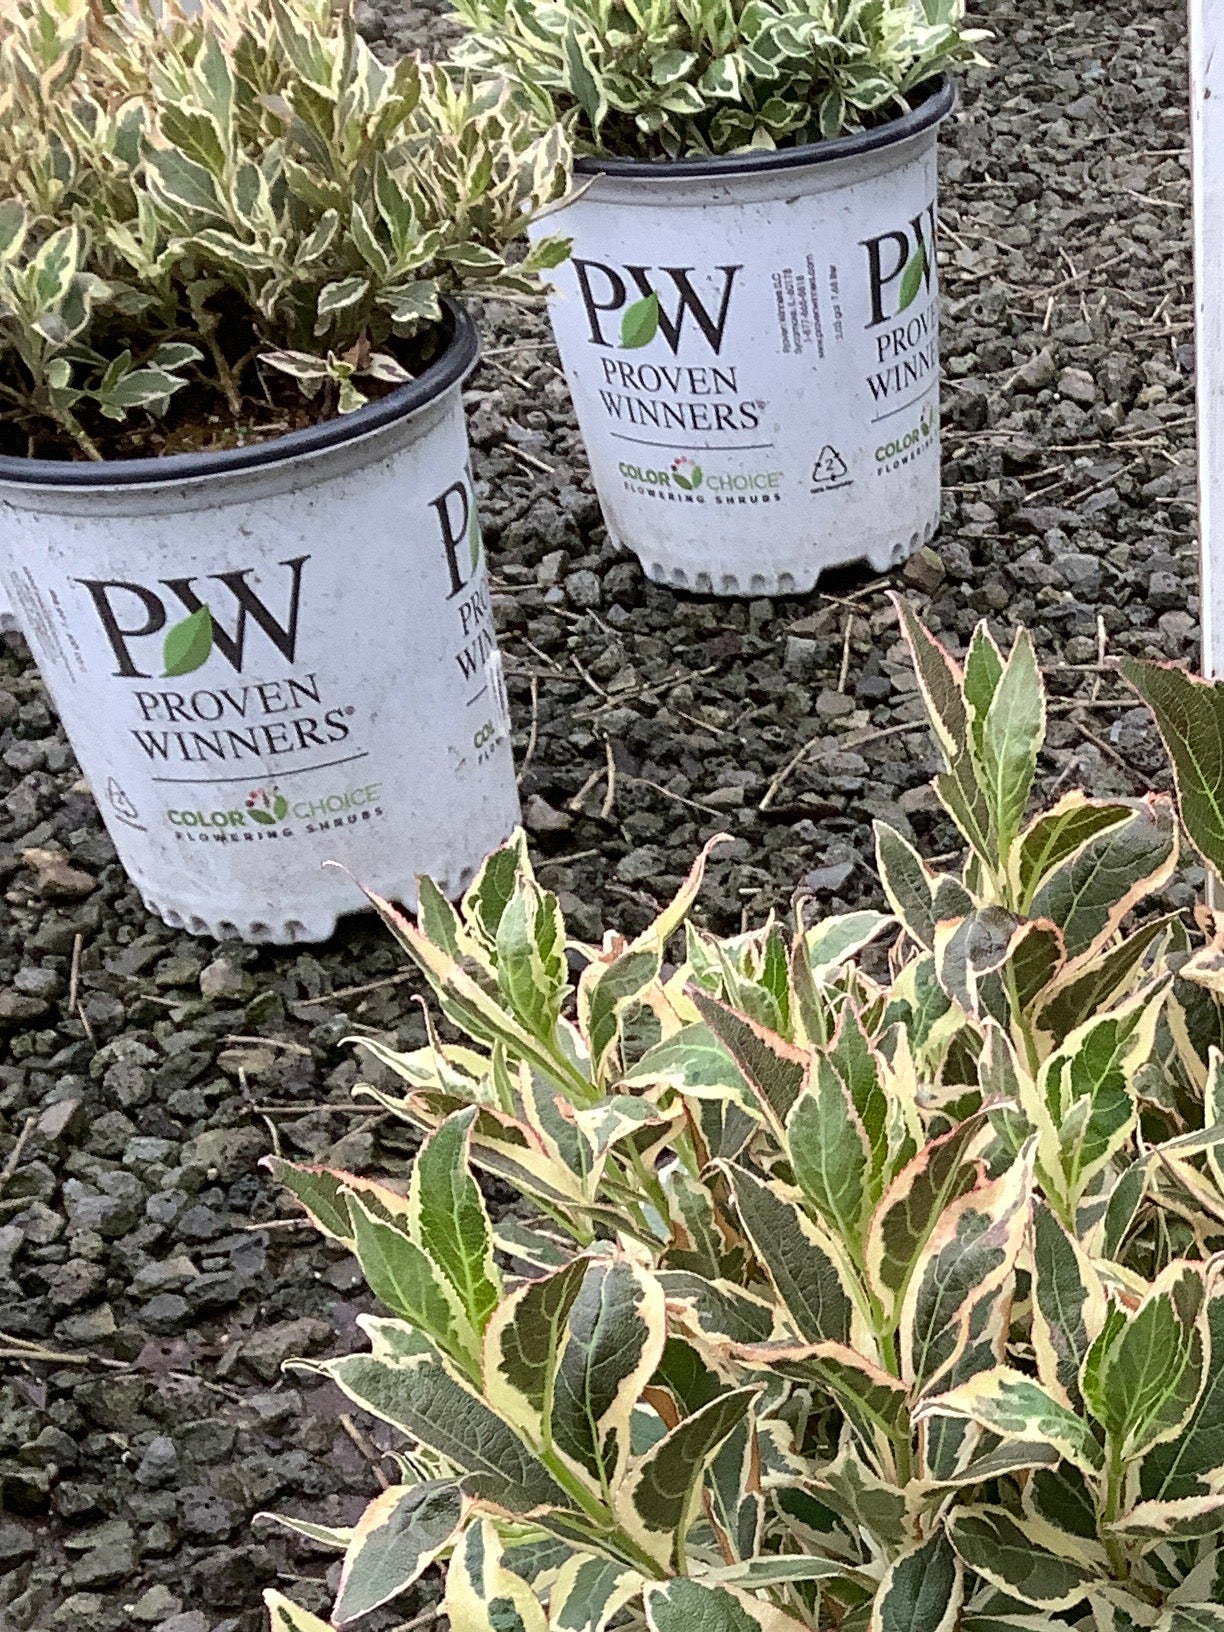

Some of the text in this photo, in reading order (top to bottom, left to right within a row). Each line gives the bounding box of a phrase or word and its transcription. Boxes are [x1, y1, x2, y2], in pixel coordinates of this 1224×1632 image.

[570, 257, 744, 356] PW
[876, 301, 937, 363] PROVE
[600, 357, 739, 396] PROVEN
[875, 428, 920, 462] COLOR
[618, 461, 671, 488] COLOR
[706, 471, 781, 492] CHOICE
[73, 554, 312, 680] PW
[133, 673, 322, 722] PROVEN
[166, 808, 246, 828] COLOR
[292, 782, 384, 820] CHOICE
[305, 806, 384, 834] SHRUBS
